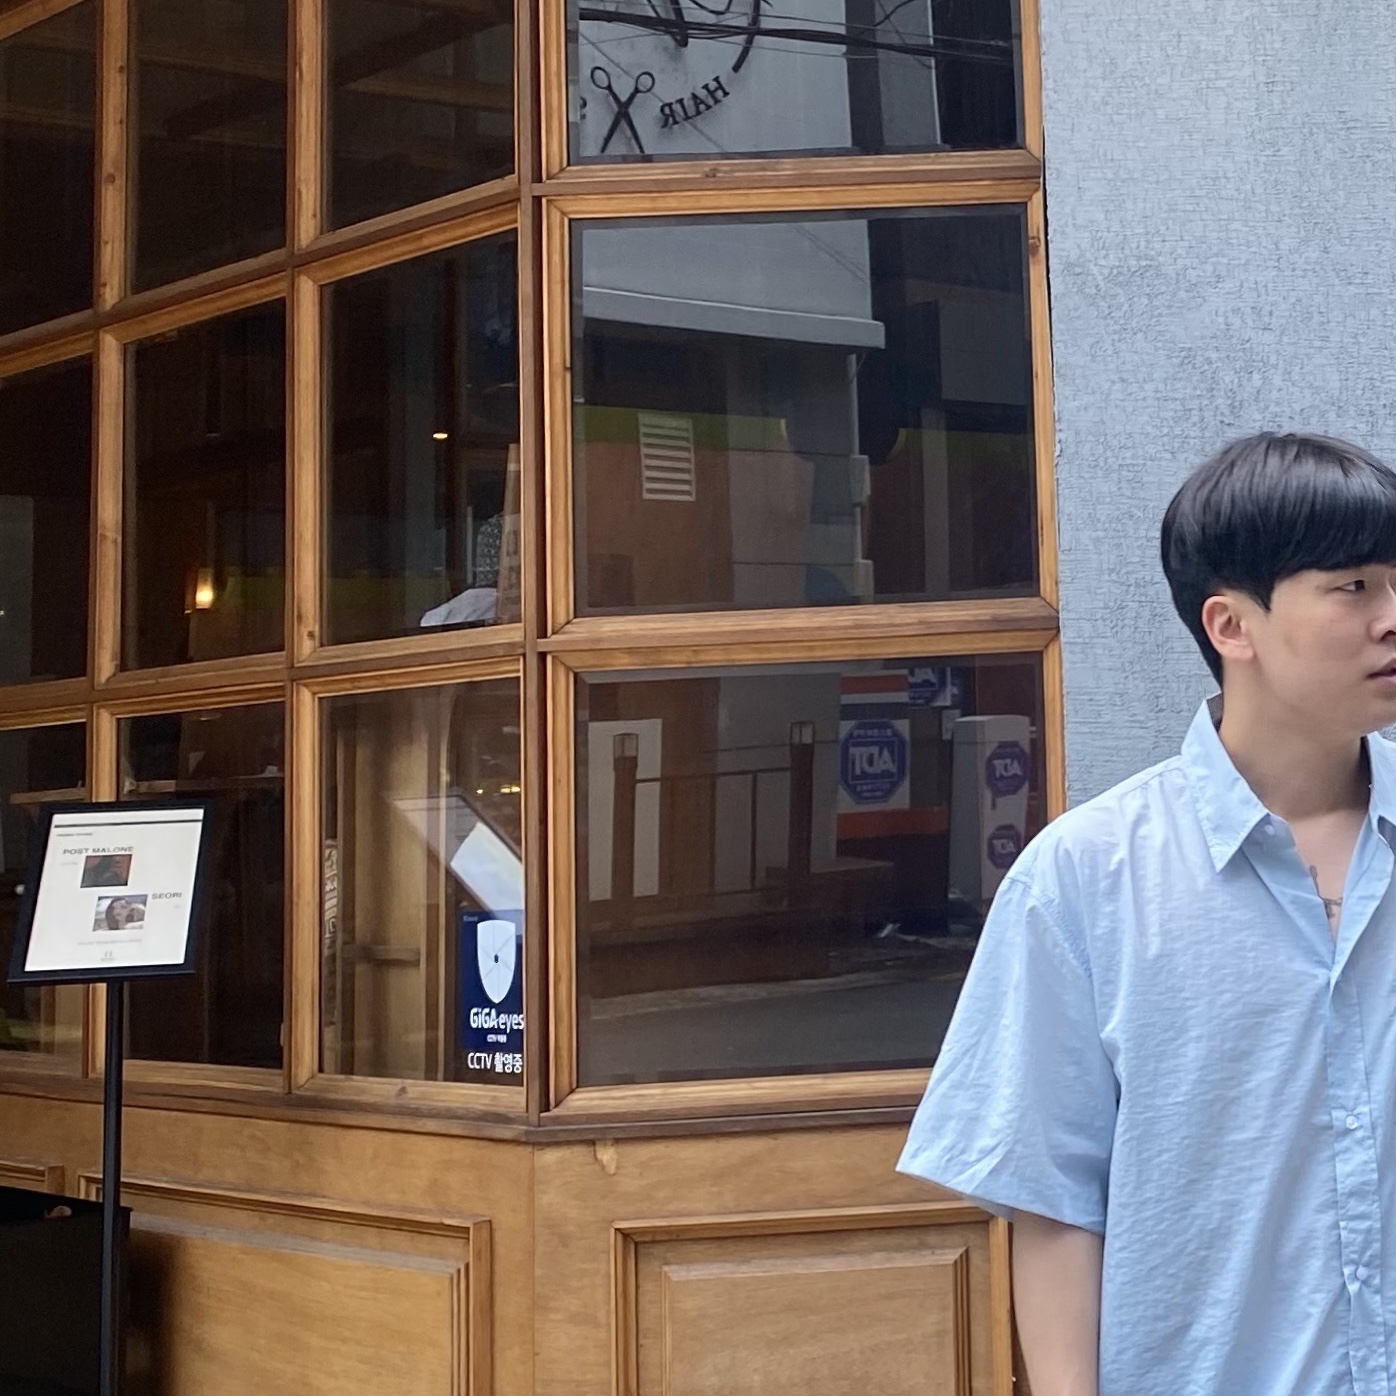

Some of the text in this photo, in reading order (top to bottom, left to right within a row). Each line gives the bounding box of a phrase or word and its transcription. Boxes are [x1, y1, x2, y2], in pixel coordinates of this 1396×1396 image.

[92, 846, 134, 854] MALONE
[467, 1052, 523, 1073] CCTV 촬영중
